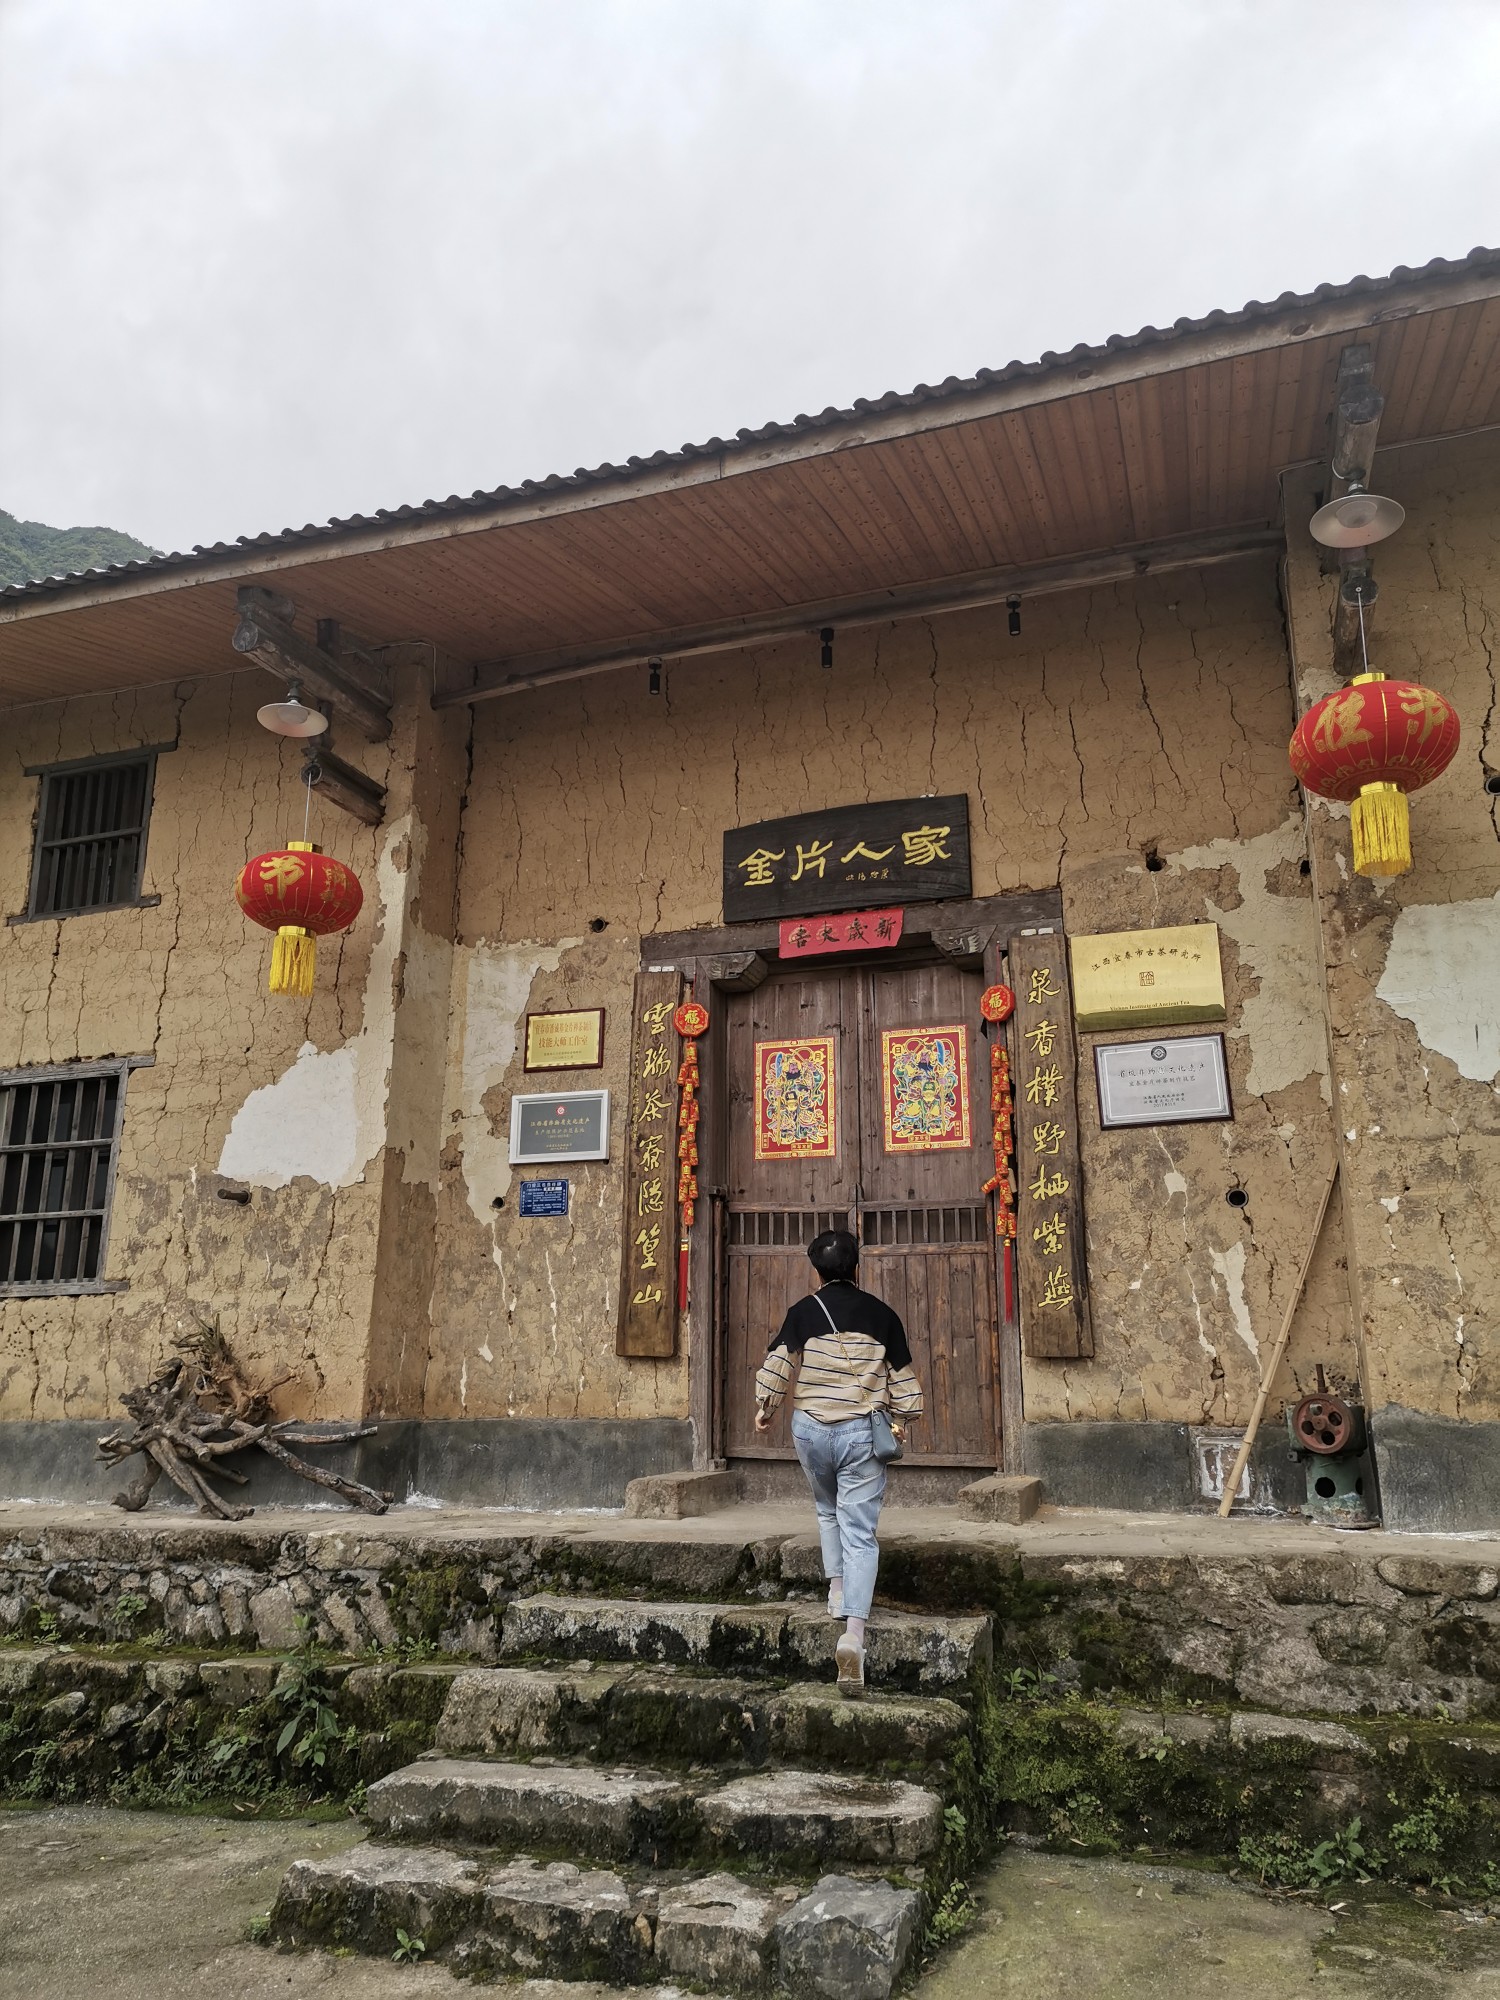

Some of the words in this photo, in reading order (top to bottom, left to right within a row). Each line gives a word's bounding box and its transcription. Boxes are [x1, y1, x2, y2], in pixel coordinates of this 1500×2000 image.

[738, 825, 951, 886] 金片人家
[1091, 947, 1202, 972] 江西宜春市古茶研究所
[538, 1035, 589, 1048] 技能大师工作室
